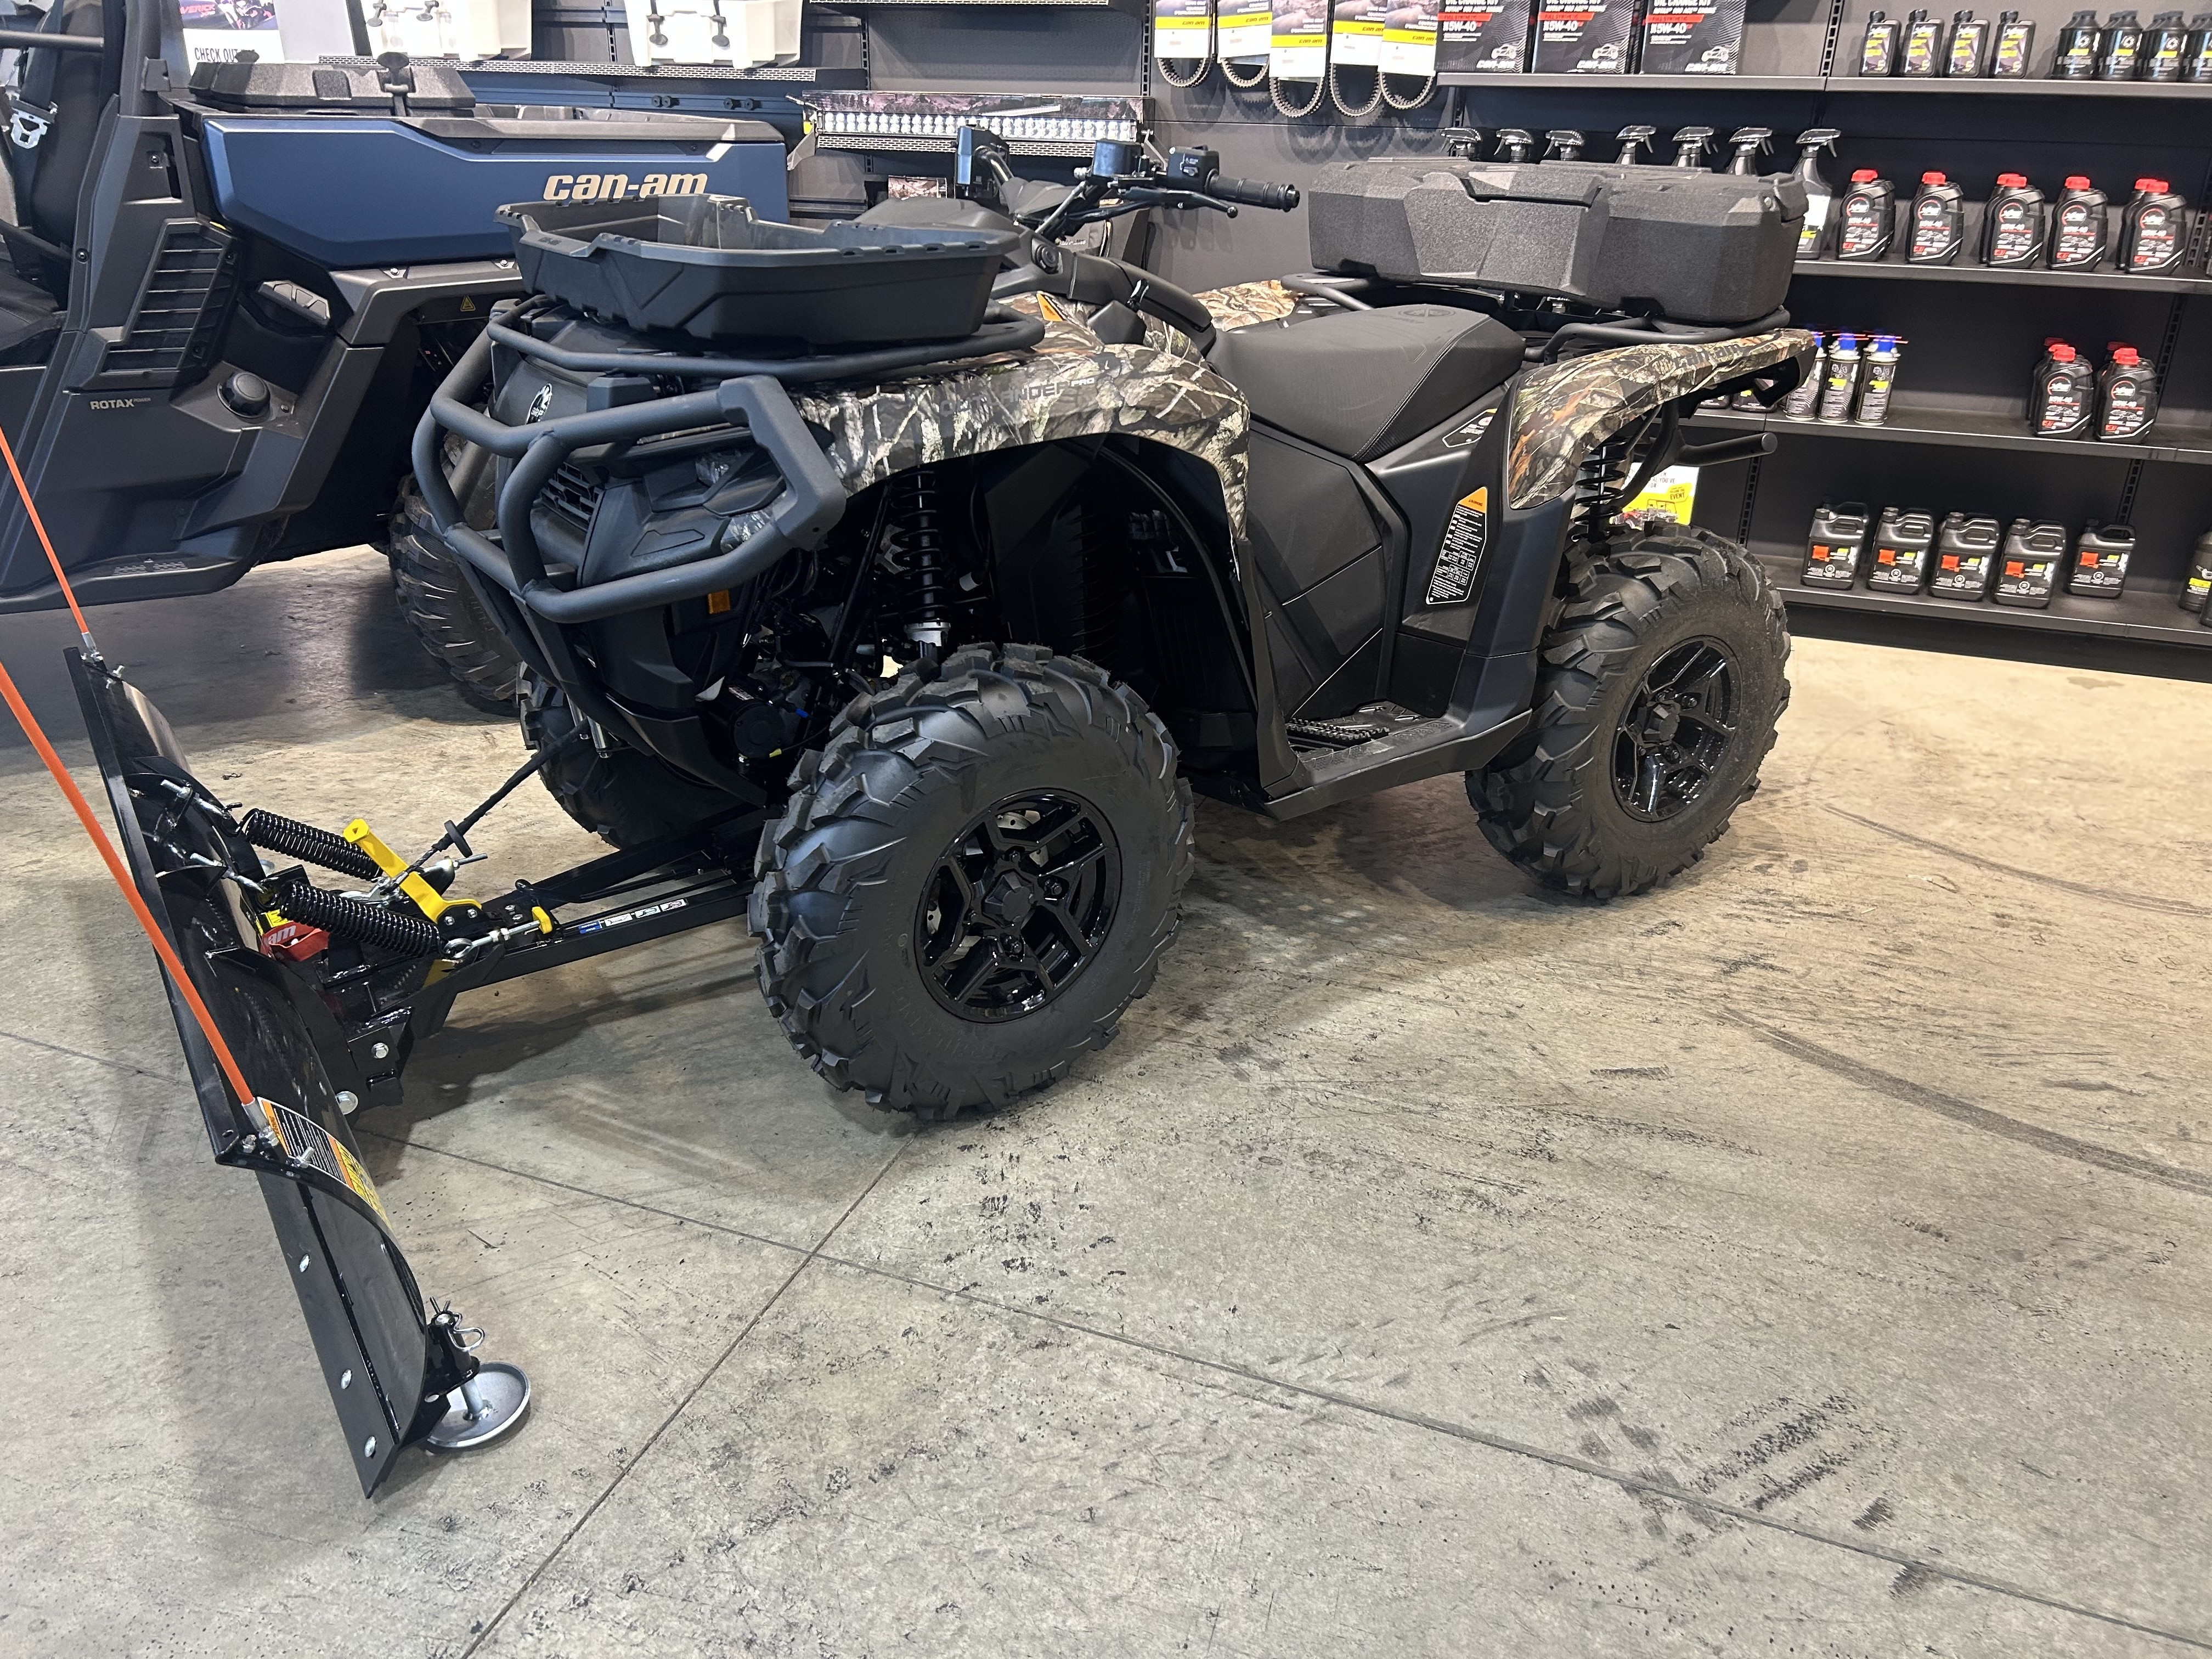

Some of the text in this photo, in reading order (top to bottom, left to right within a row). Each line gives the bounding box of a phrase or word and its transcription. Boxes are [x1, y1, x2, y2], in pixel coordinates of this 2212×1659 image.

[194, 47, 222, 63] CHECK
[543, 173, 708, 200] can-am
[1071, 377, 1096, 387] PRO
[89, 398, 134, 410] ROTAX
[1670, 492, 1685, 500] EVENT
